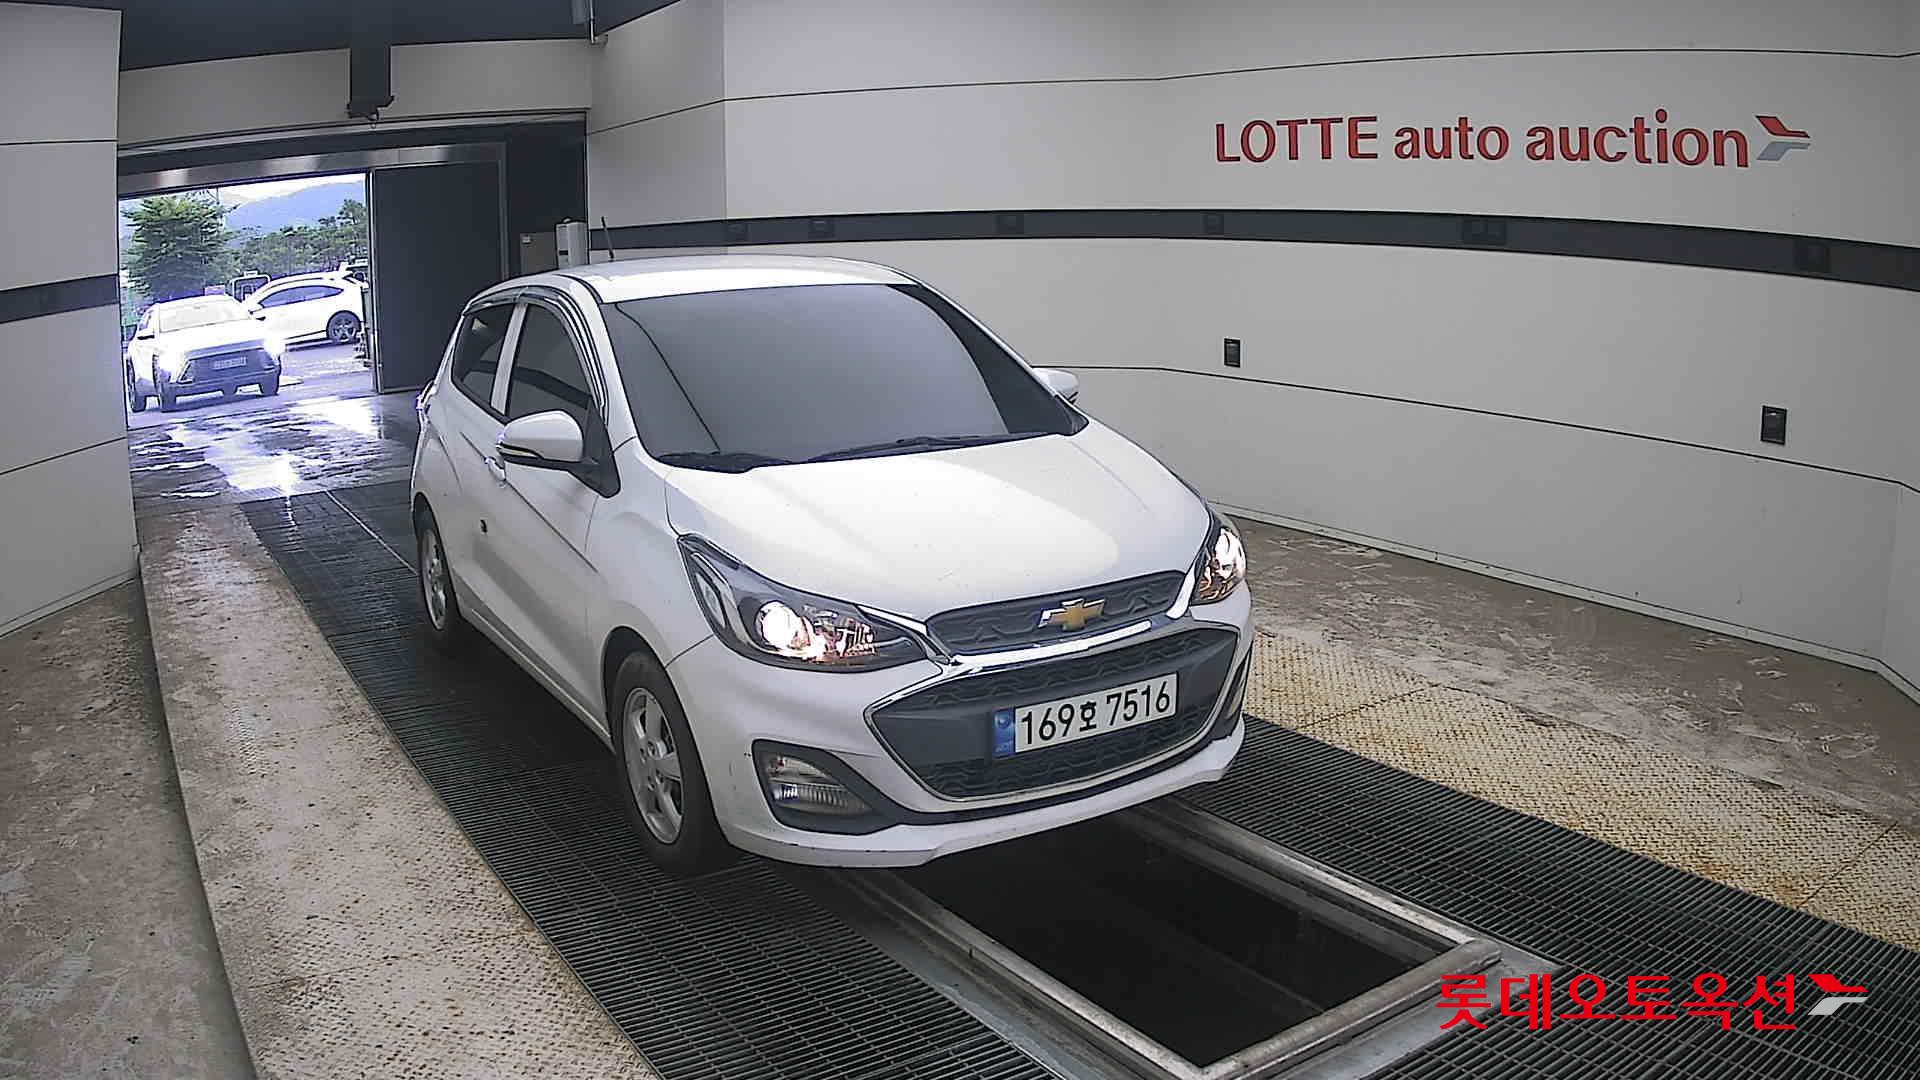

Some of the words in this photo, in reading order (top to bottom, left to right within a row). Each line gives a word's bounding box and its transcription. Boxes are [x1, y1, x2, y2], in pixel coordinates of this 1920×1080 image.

[1216, 116, 1378, 162] LOTTE
[1394, 117, 1510, 161] auto
[1526, 109, 1749, 168] auction
[1020, 700, 1097, 745] 169호
[1106, 680, 1171, 726] 7516
